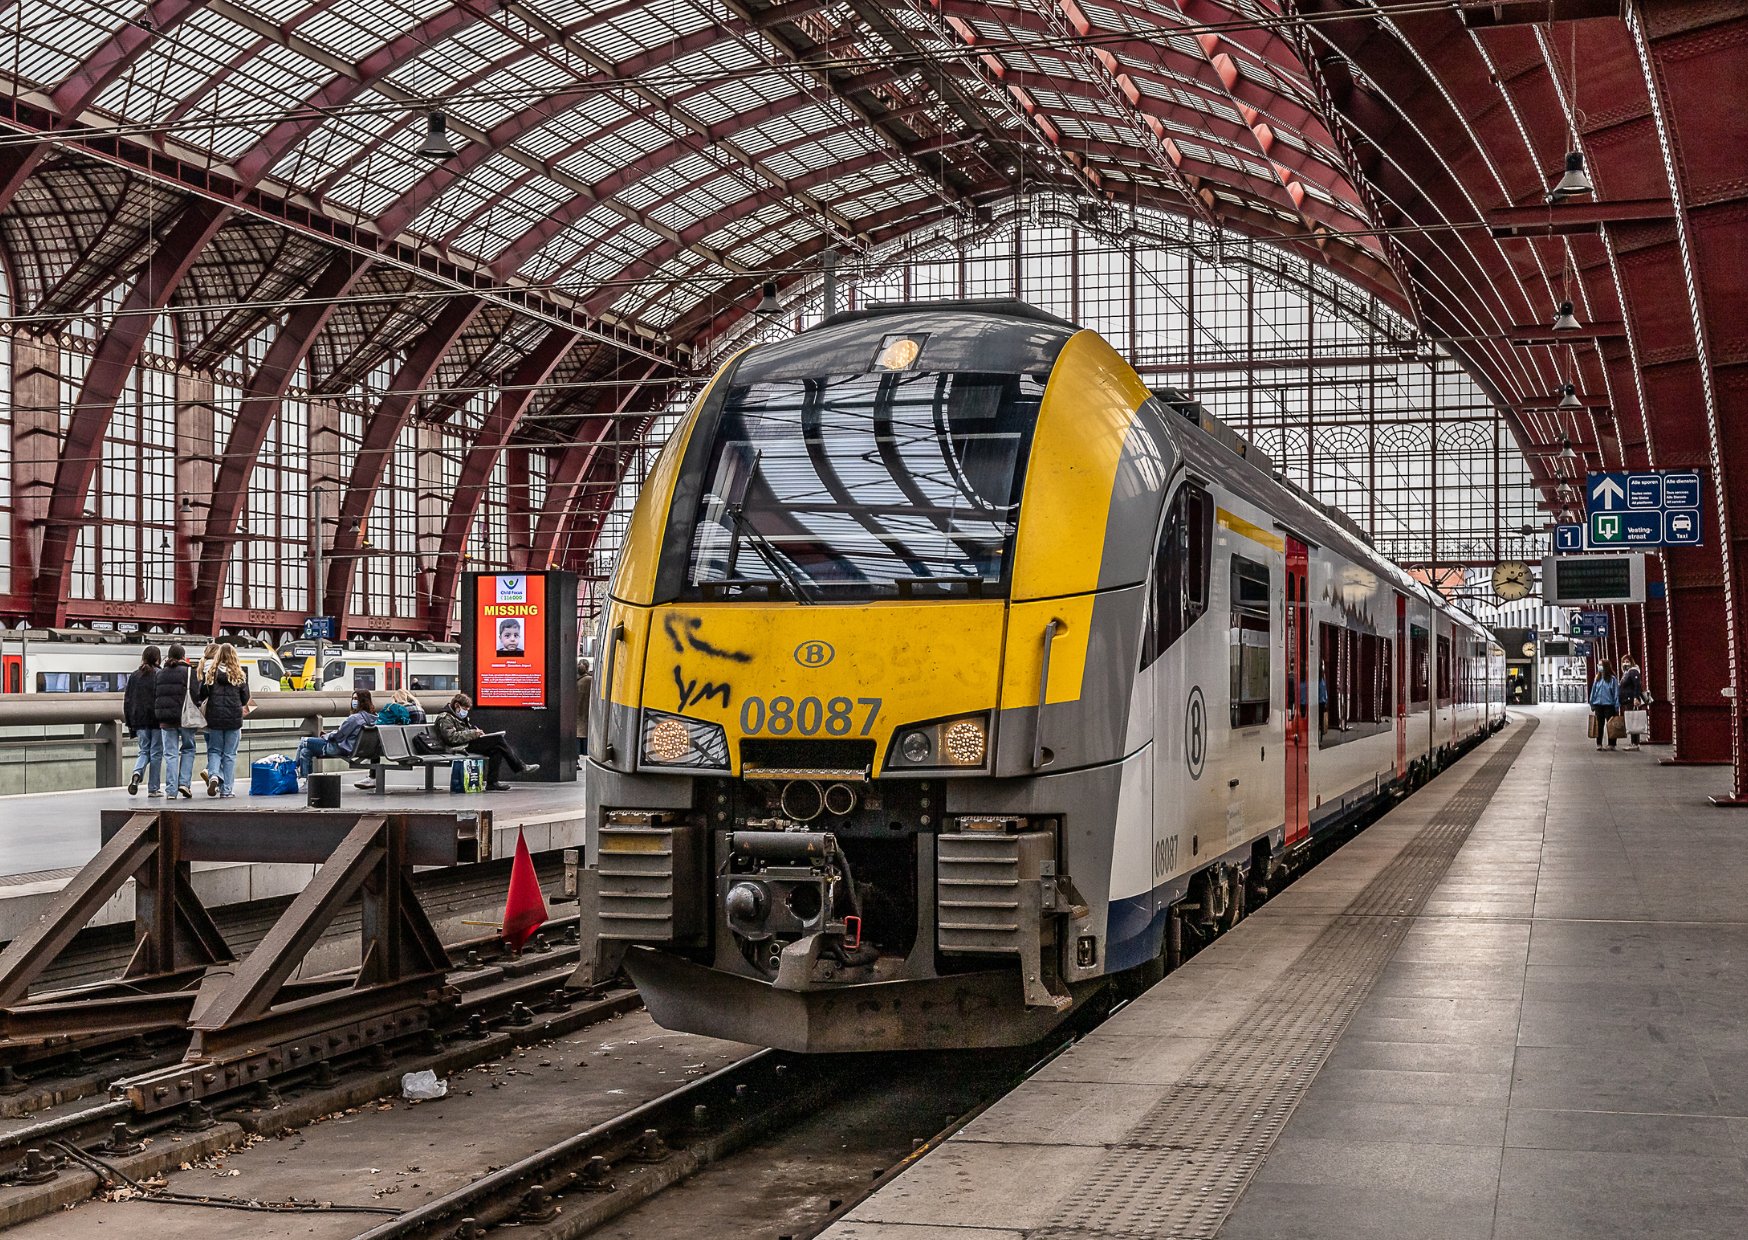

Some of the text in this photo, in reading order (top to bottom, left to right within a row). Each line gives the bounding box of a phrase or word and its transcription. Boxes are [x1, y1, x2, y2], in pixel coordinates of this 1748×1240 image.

[1564, 532, 1572, 546] 1
[484, 605, 538, 616] MISSING
[739, 696, 883, 737] 08087
[1155, 834, 1179, 878] 08087
